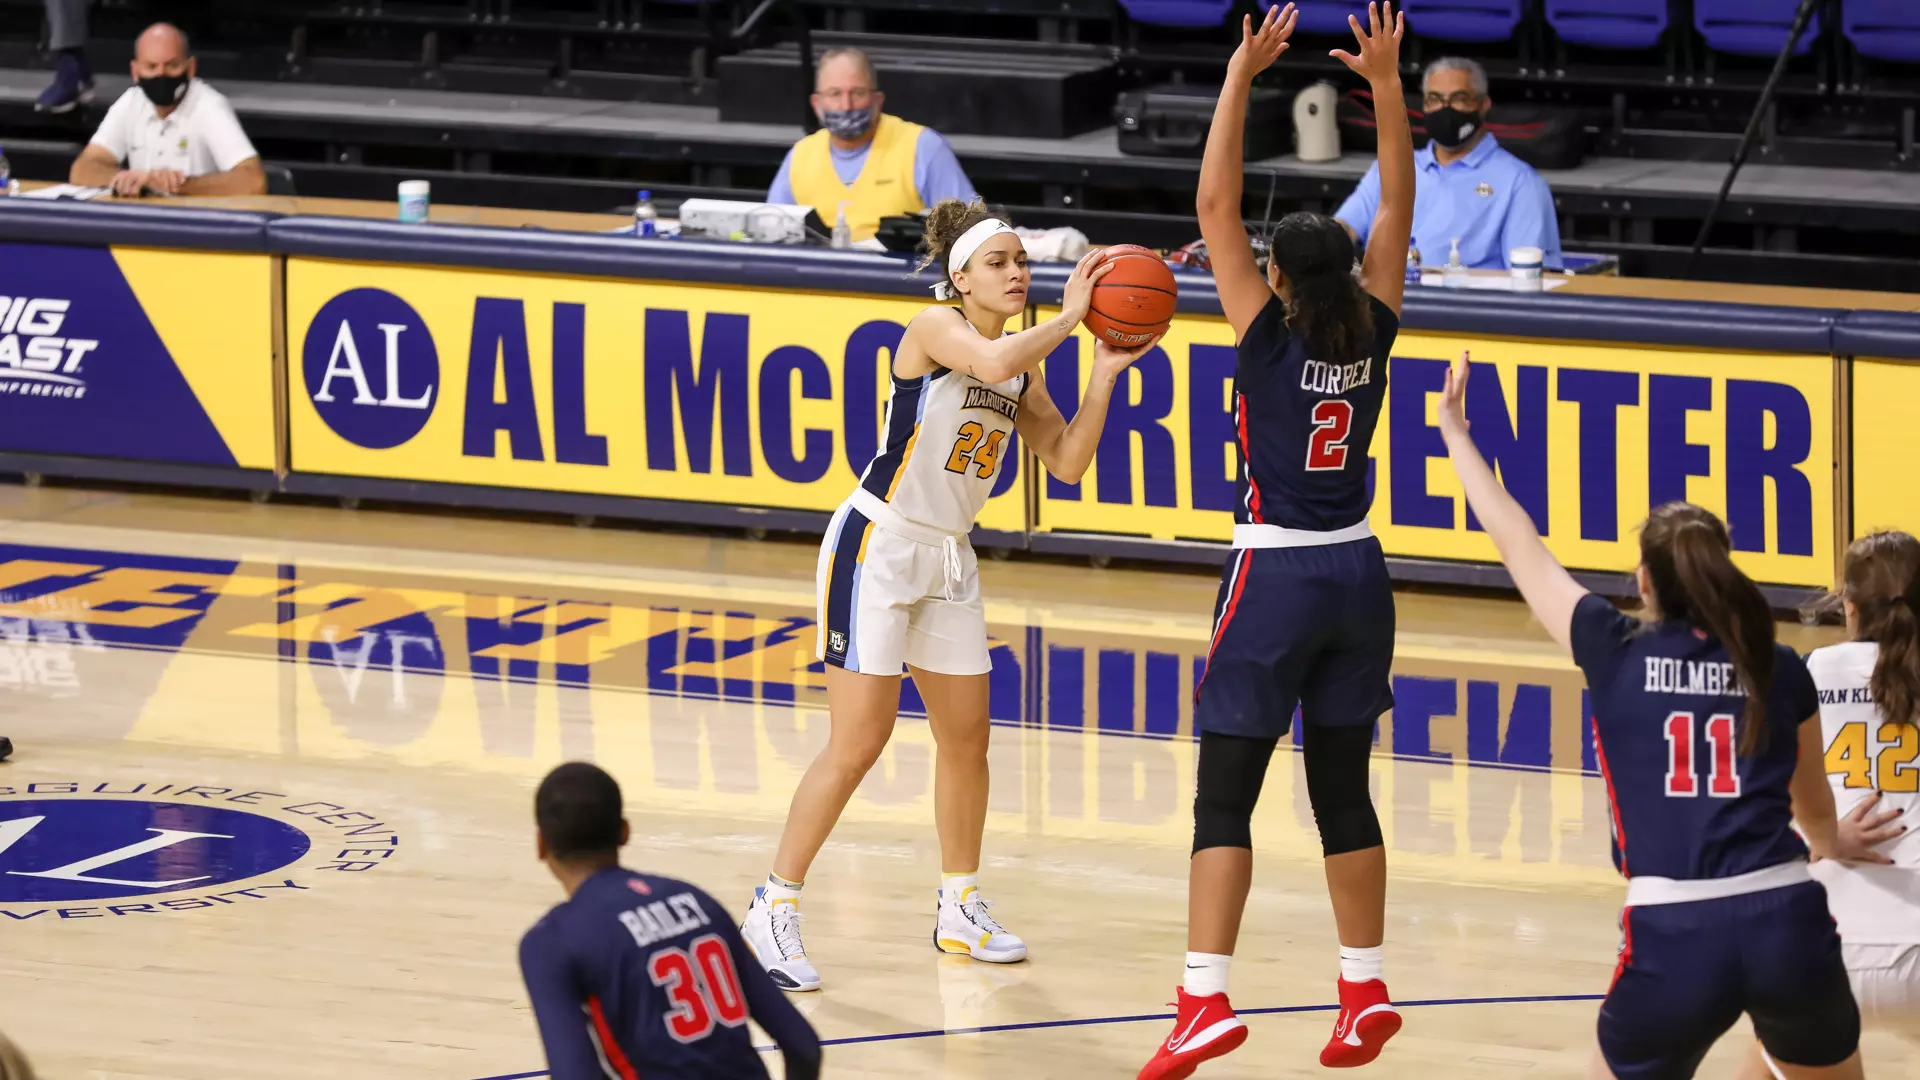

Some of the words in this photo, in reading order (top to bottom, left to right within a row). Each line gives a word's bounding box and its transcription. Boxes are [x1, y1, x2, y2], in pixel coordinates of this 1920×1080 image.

[313, 319, 432, 409] AL
[1300, 357, 1373, 394] CORREA
[462, 296, 609, 466] AL
[644, 308, 1238, 511] McIRE
[1366, 356, 1813, 557] ENTER
[961, 387, 1019, 423] MARQUETT
[1305, 399, 1354, 471] 2
[944, 421, 1006, 479] 24
[829, 630, 847, 653] MU
[1818, 689, 1848, 704] VAN
[1664, 711, 1741, 798] 11
[1823, 721, 1919, 793] 42
[0, 815, 235, 888] L
[282, 801, 399, 872] CENTER
[618, 892, 712, 948] BAILEY
[647, 933, 748, 1044] 30
